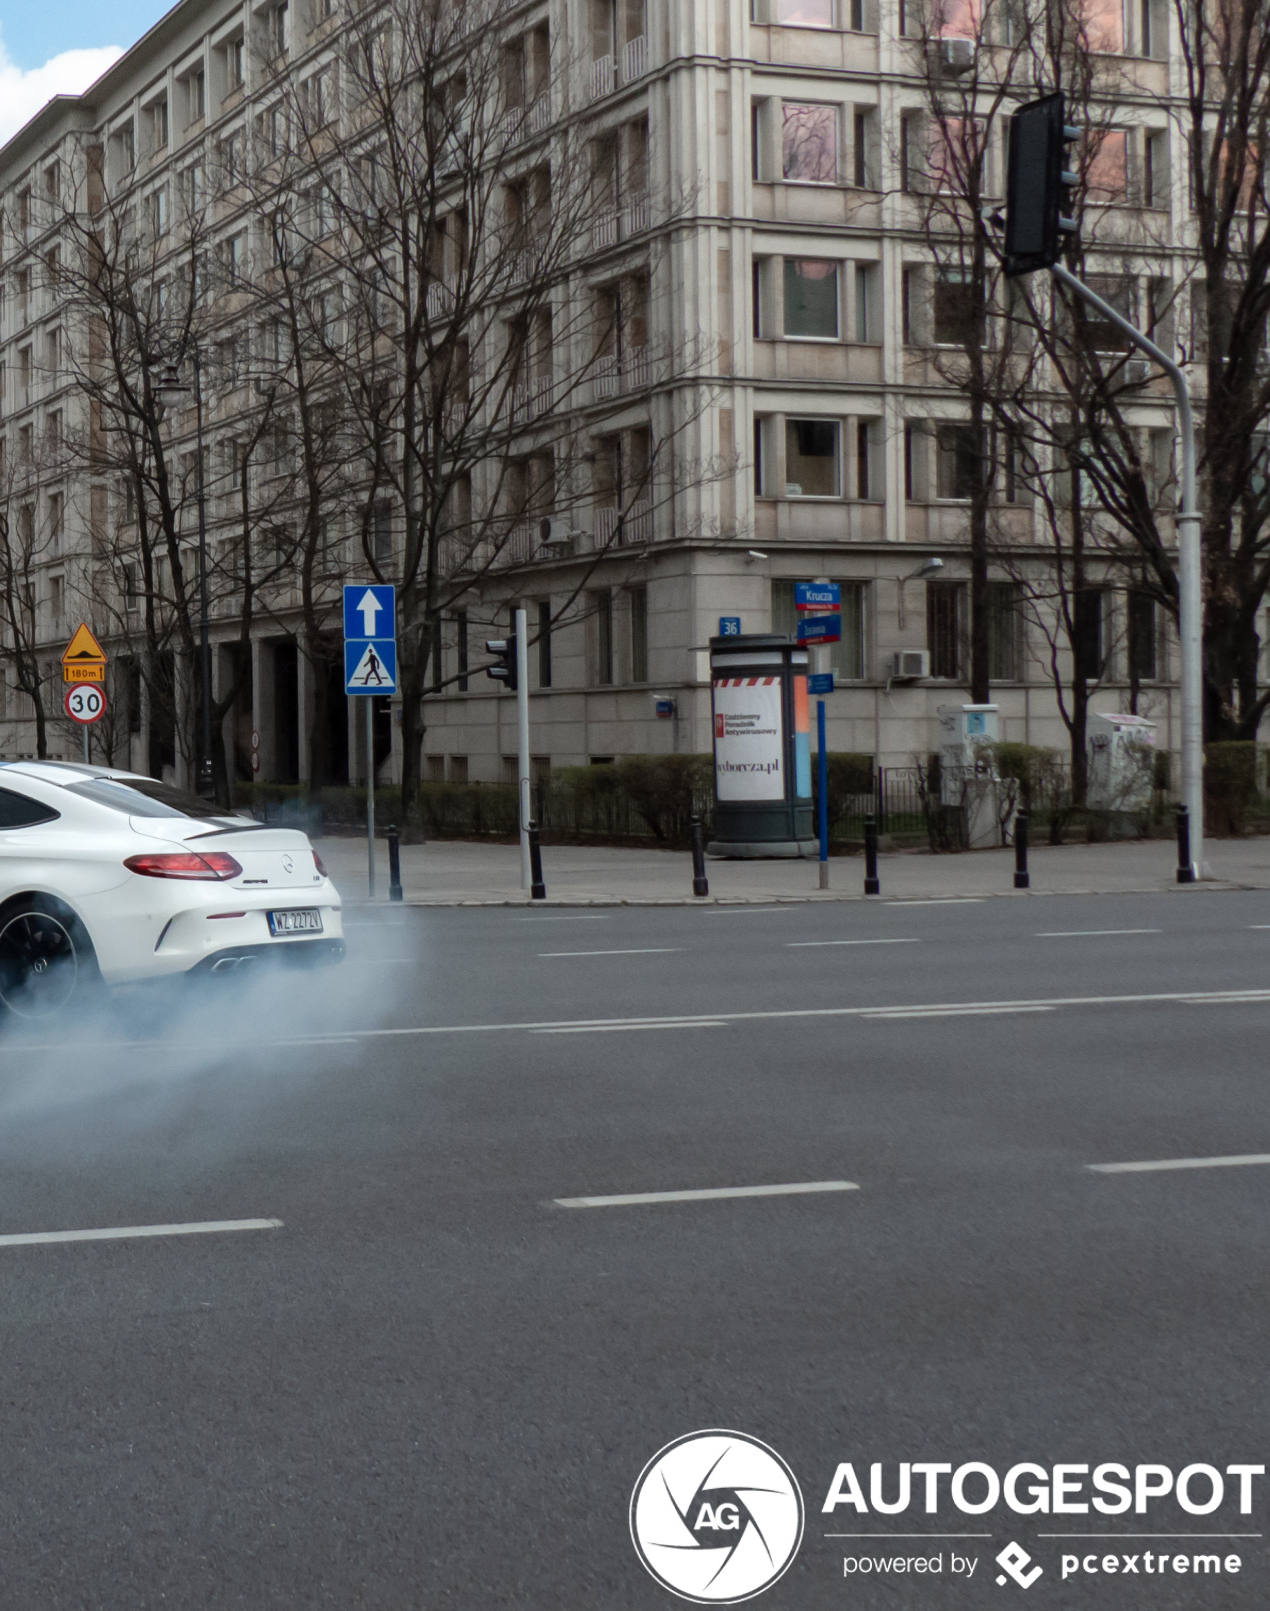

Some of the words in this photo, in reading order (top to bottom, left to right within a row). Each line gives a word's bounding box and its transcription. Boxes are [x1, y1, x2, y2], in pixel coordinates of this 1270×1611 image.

[806, 591, 833, 601] Krucza
[724, 622, 737, 635] 36
[72, 694, 100, 713] 30
[275, 913, 291, 930] WZ
[291, 911, 319, 929] 2272V
